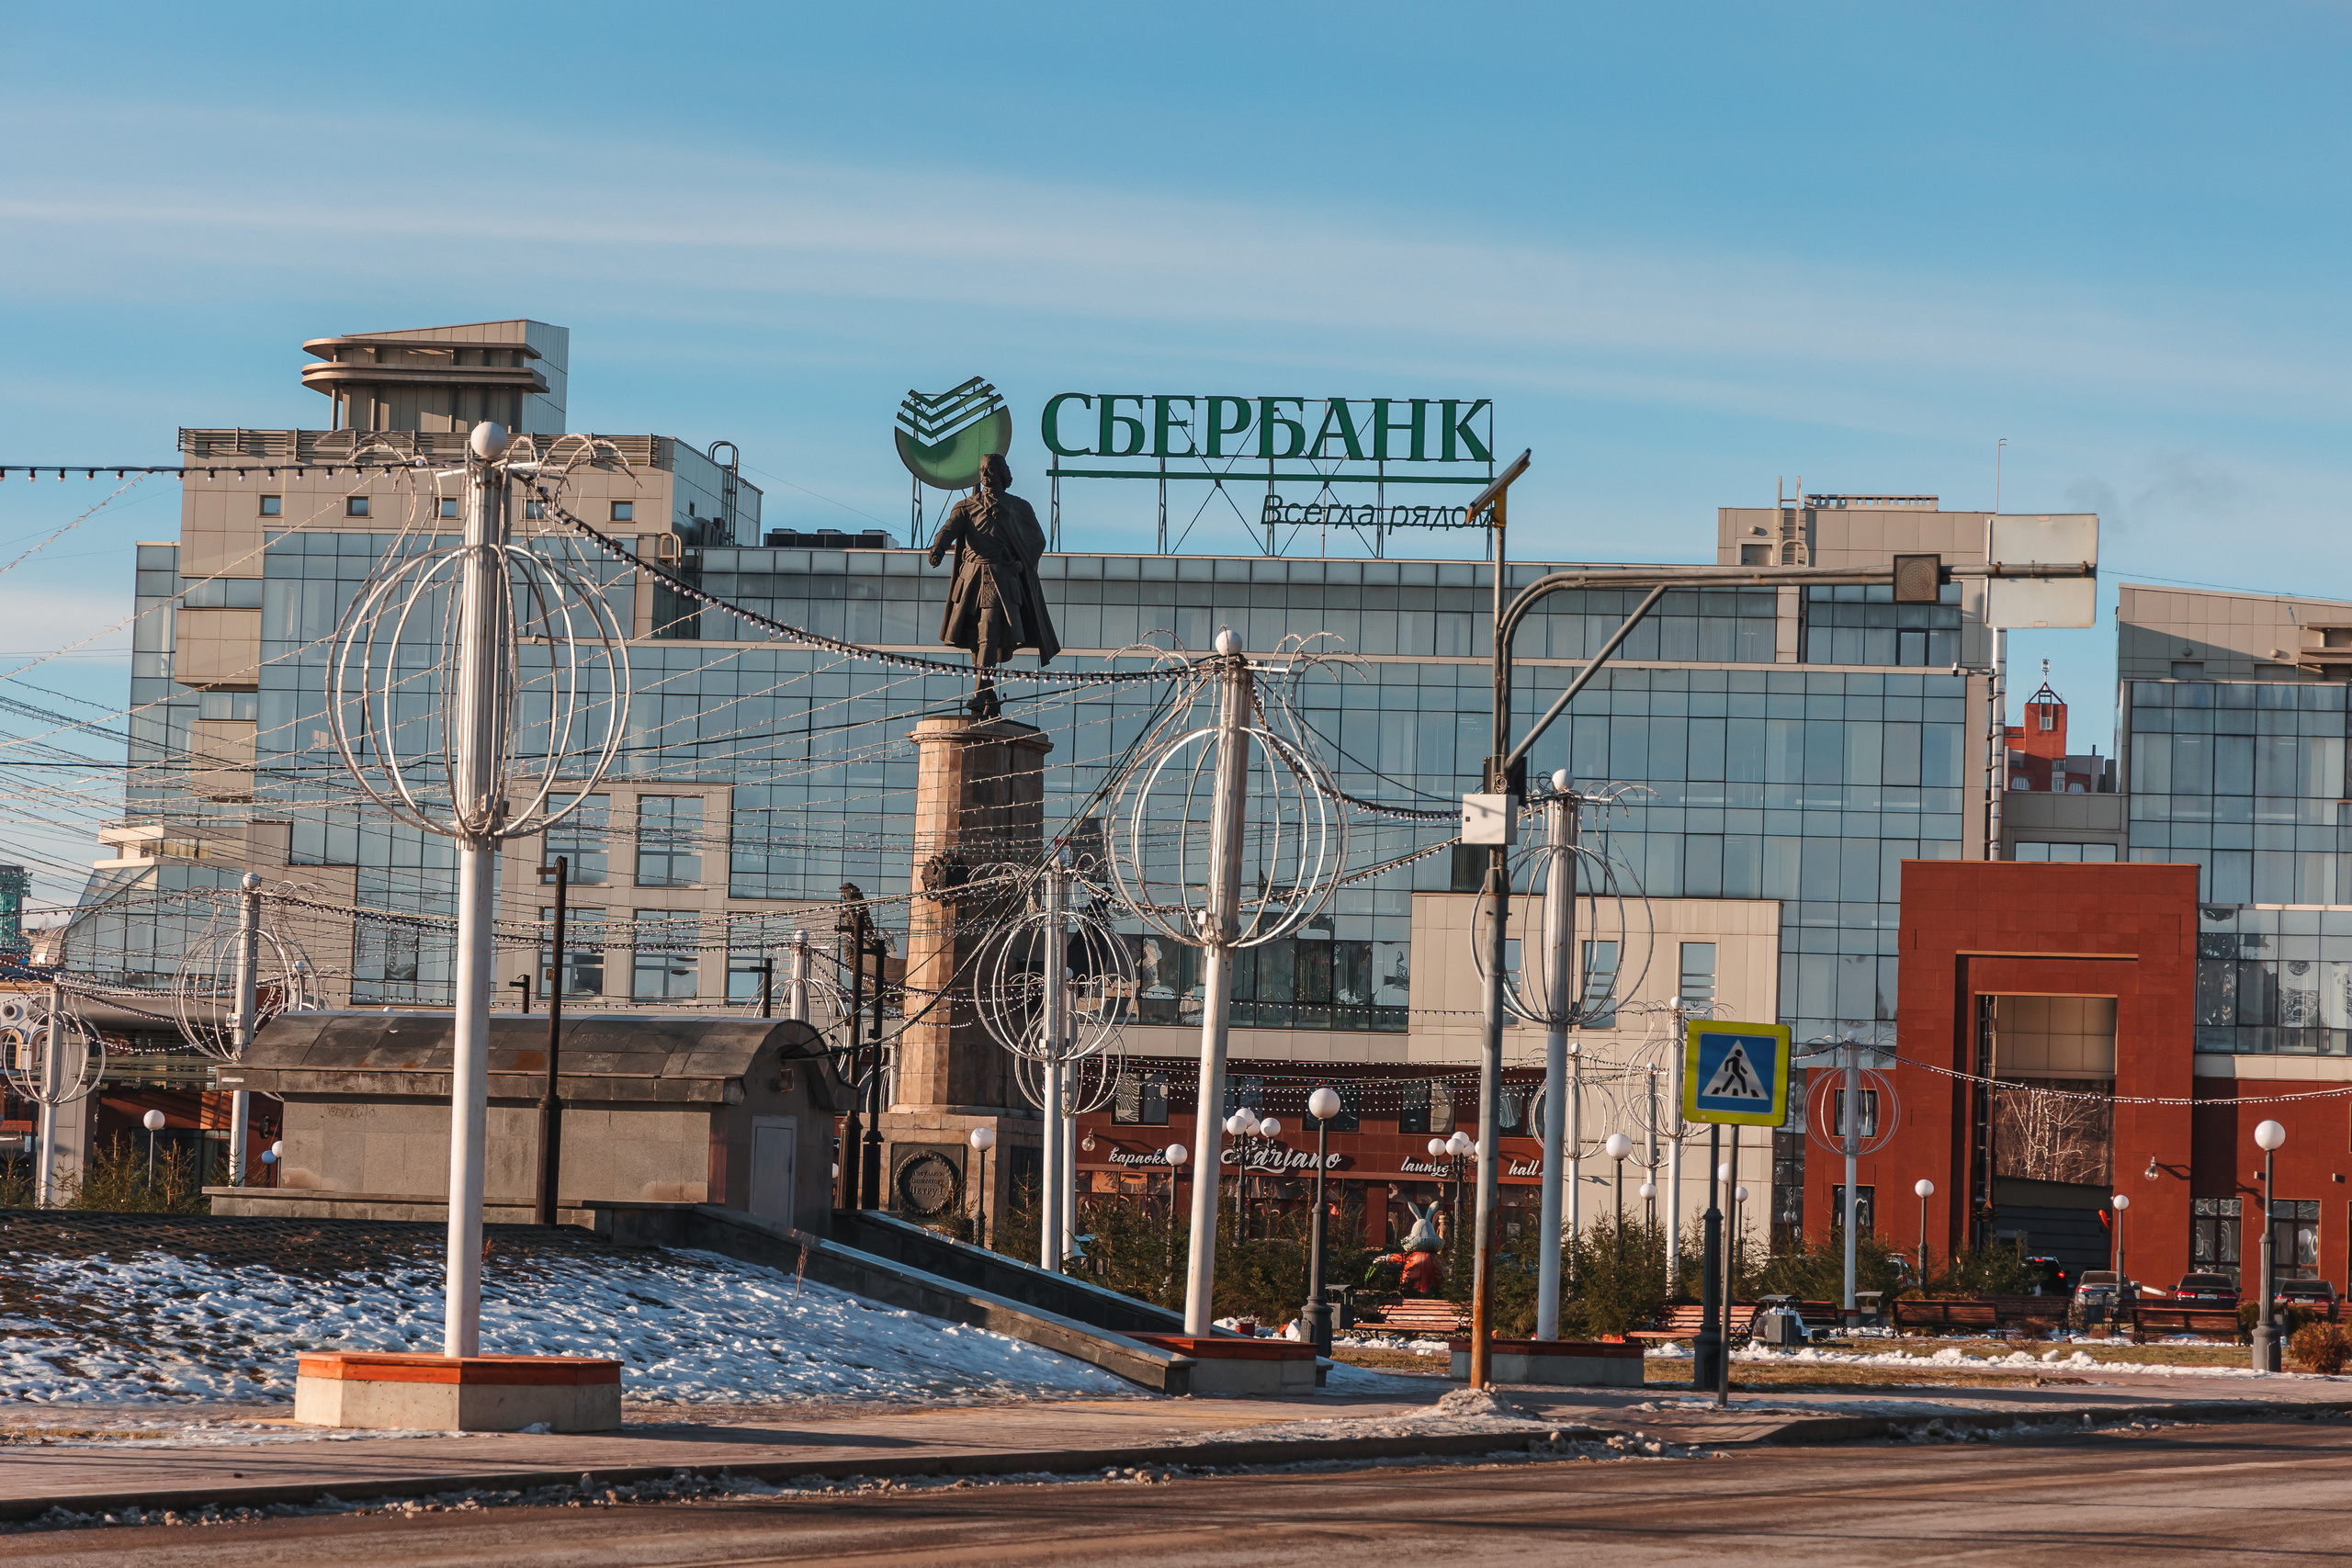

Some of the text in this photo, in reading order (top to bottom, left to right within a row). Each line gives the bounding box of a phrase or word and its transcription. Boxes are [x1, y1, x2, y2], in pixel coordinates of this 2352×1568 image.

[1041, 392, 1497, 463] СБЕРБАНК
[1260, 494, 1375, 530] Всегда
[1508, 1159, 1540, 1177] hall
